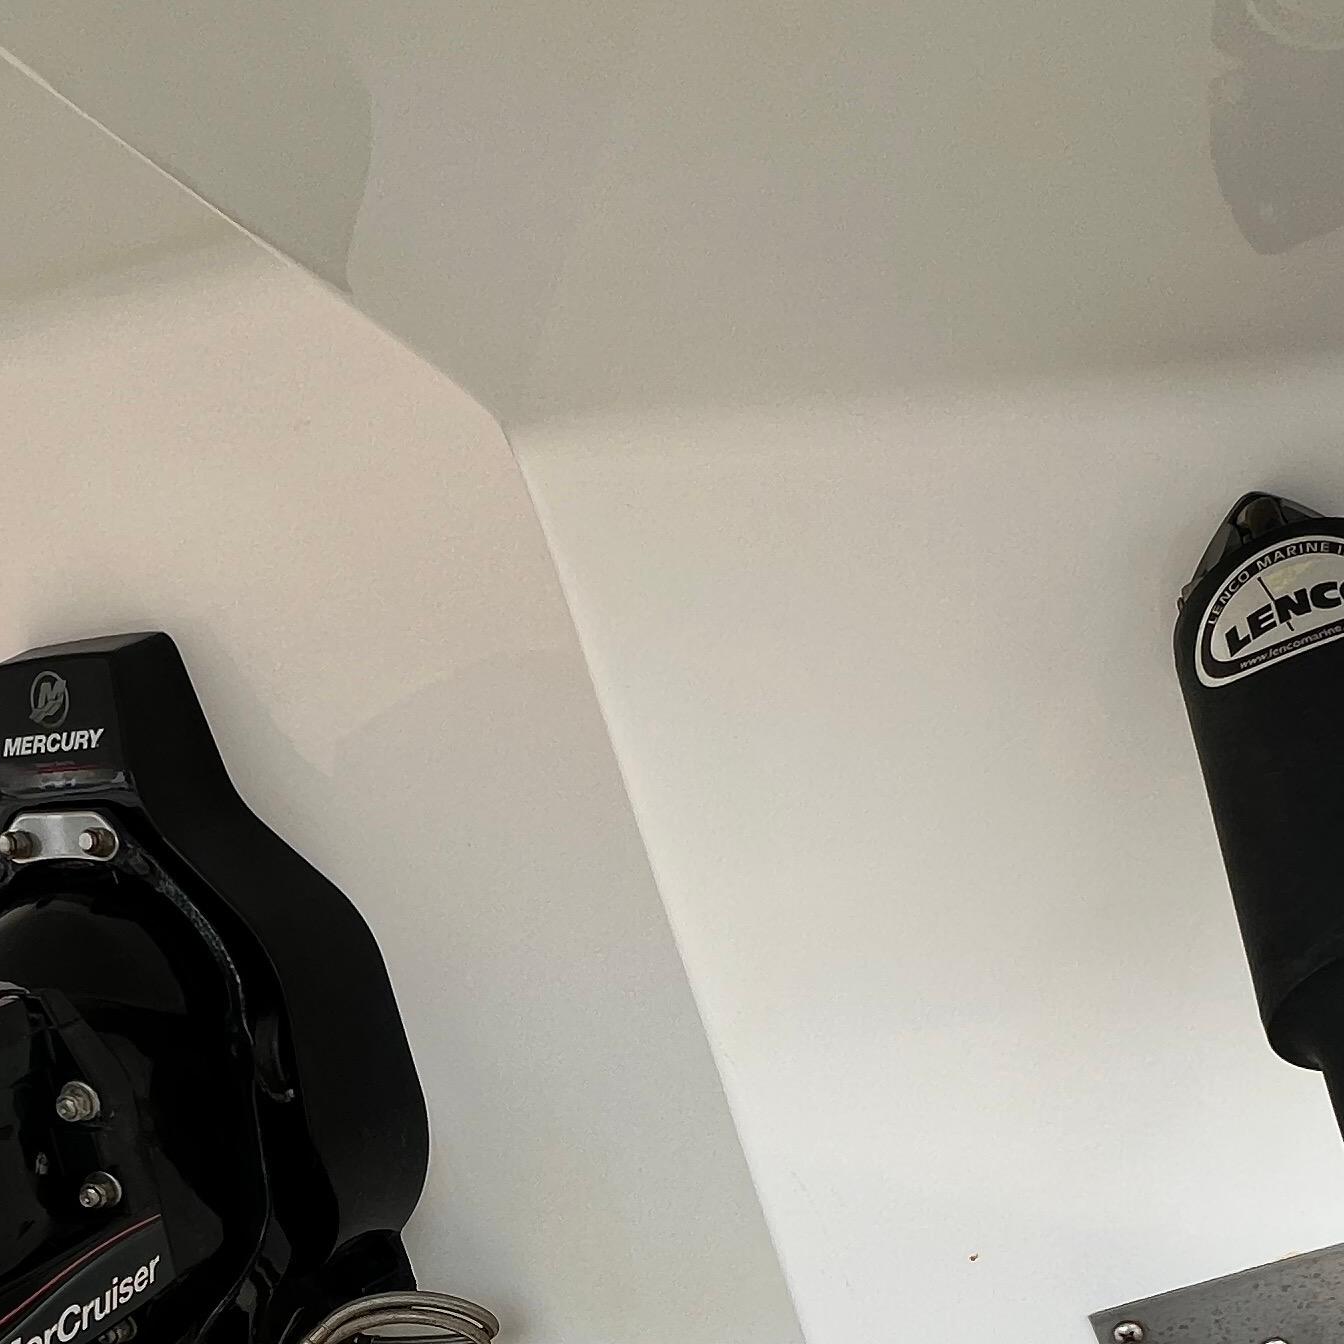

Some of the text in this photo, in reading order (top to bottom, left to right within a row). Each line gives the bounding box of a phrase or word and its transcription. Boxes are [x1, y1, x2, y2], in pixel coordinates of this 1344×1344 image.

[1207, 570, 1250, 625] LENCO
[1256, 542, 1330, 571] MARINE
[3, 728, 104, 757] MERCURY
